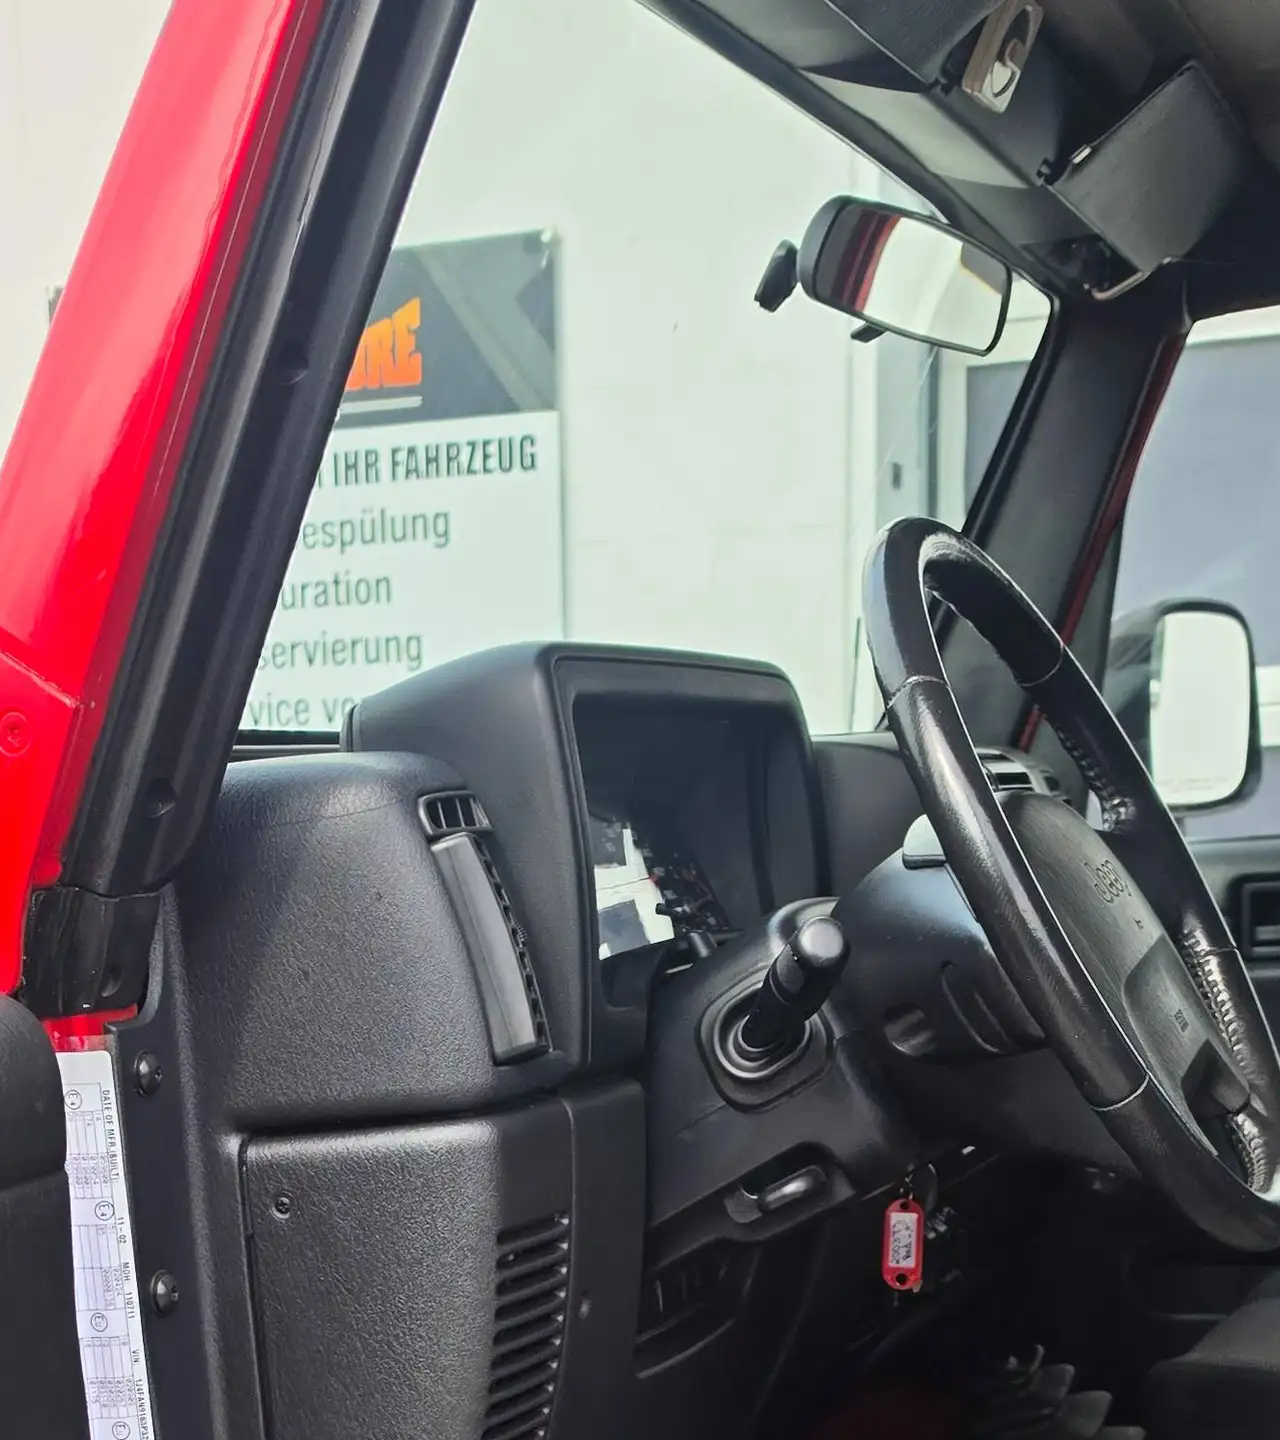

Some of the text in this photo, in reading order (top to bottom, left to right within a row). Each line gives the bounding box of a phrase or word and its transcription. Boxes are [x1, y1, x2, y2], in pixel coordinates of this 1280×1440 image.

[344, 296, 423, 390] RE
[334, 434, 537, 488] IHR FAHRZEUG
[301, 508, 451, 555] espülung
[280, 569, 393, 611] uration
[248, 692, 310, 727] vice
[102, 1089, 112, 1111] DATE
[105, 1114, 114, 1125] OF
[125, 1291, 136, 1319] 110711
